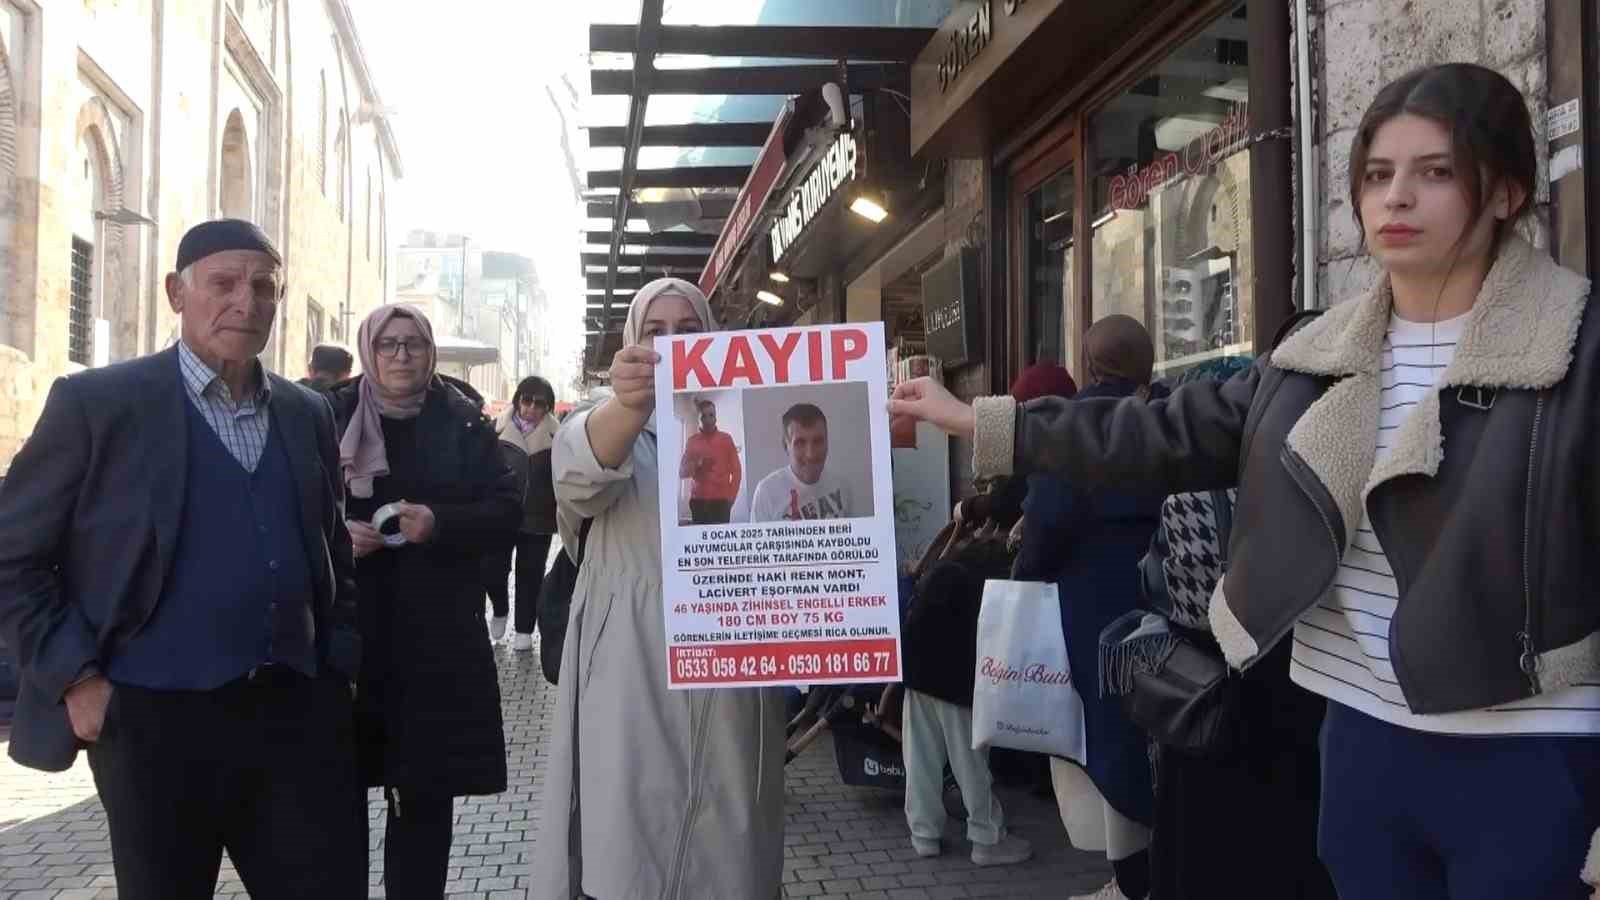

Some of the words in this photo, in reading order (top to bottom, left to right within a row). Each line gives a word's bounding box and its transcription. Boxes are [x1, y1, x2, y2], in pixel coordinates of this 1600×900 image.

[801, 133, 857, 226] KURUYEMİŞ
[1110, 152, 1178, 209] Gören
[672, 329, 868, 389] KAYIP
[702, 531, 708, 540] 8
[710, 529, 737, 540] OCAK
[740, 528, 763, 539] 2025
[766, 525, 826, 537] TARİHİNDEN
[829, 523, 852, 535] BERİ
[684, 543, 753, 554] KUYUMCULAR
[755, 539, 815, 552] ÇARŞISINDA
[818, 537, 871, 548] KAYBOLDU
[678, 556, 691, 567] EN
[694, 555, 714, 566] SON
[717, 552, 770, 565] TELEFERİK
[773, 550, 828, 563] TARAFINDA
[831, 548, 879, 561] GÖRÜLDÜ
[692, 572, 754, 585] ÜZERİNDE
[757, 571, 786, 583] HAKİ
[791, 569, 824, 581] RENK
[828, 568, 866, 579] MONT,
[699, 586, 757, 598] LACİVERT
[761, 583, 820, 597] EŞOFMAN
[824, 582, 860, 593] VARDI
[674, 603, 688, 613] 46
[691, 601, 739, 614] YAŞINDA
[742, 598, 794, 612] ZİHİNSEL
[797, 597, 845, 609] ENGELLİ
[848, 595, 886, 607] ERKEK
[718, 616, 741, 627] 180
[746, 614, 766, 626] CM
[771, 613, 798, 625] BOY
[803, 612, 820, 623] 75
[824, 611, 844, 622] KG
[673, 631, 731, 642] GÖRENLERİN
[734, 629, 779, 641] İLETİŞİME
[782, 627, 822, 639] GEÇMESİ
[825, 626, 847, 637] RİCA
[677, 658, 708, 678] 0533
[712, 656, 736, 678] 058
[740, 655, 757, 676] 42
[760, 655, 777, 675] 64
[788, 653, 821, 674] 0530
[825, 652, 848, 673] 181
[853, 652, 870, 672] 66
[873, 650, 891, 672] 77
